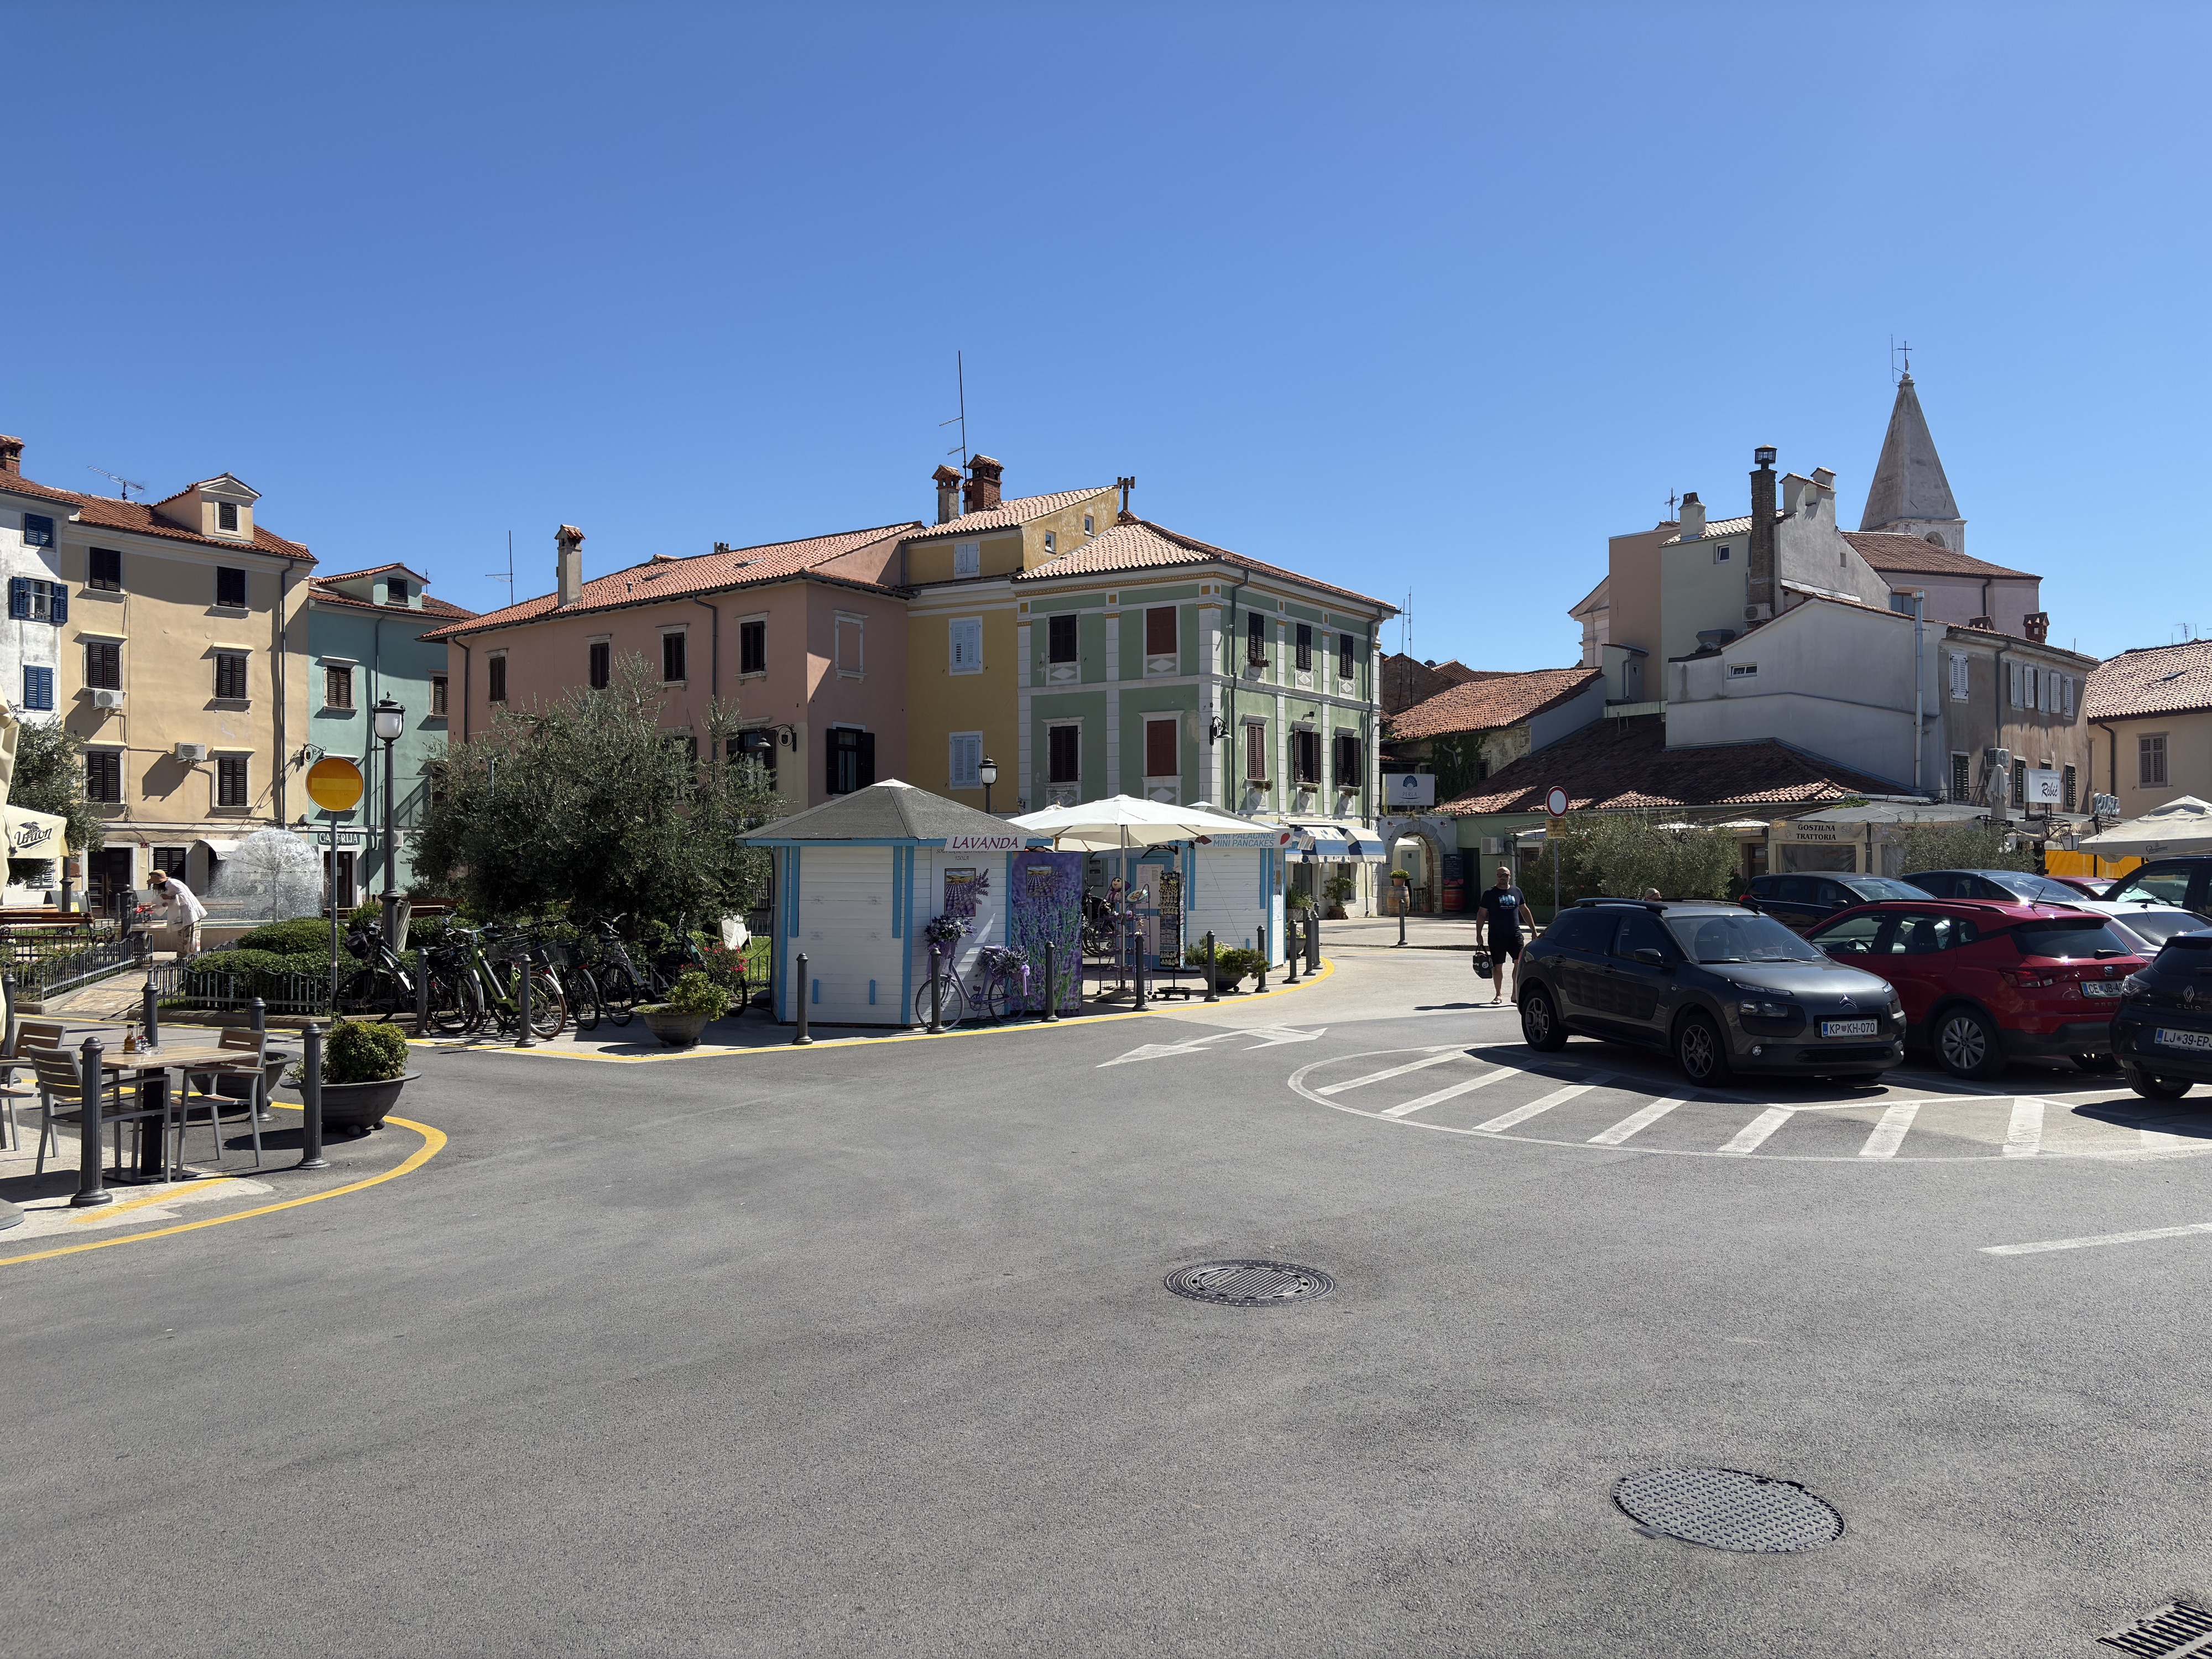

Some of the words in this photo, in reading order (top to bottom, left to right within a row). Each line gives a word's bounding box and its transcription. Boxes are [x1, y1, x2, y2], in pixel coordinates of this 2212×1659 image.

[14, 828, 53, 846] Union
[319, 833, 358, 844] GAERIJA
[952, 836, 1019, 851] LAVANDA
[2089, 984, 2099, 993] CE
[2104, 983, 2124, 993] JB-40
[1829, 1024, 1840, 1034] KP
[1848, 1022, 1875, 1034] KH-070
[2164, 1031, 2176, 1043] LJ
